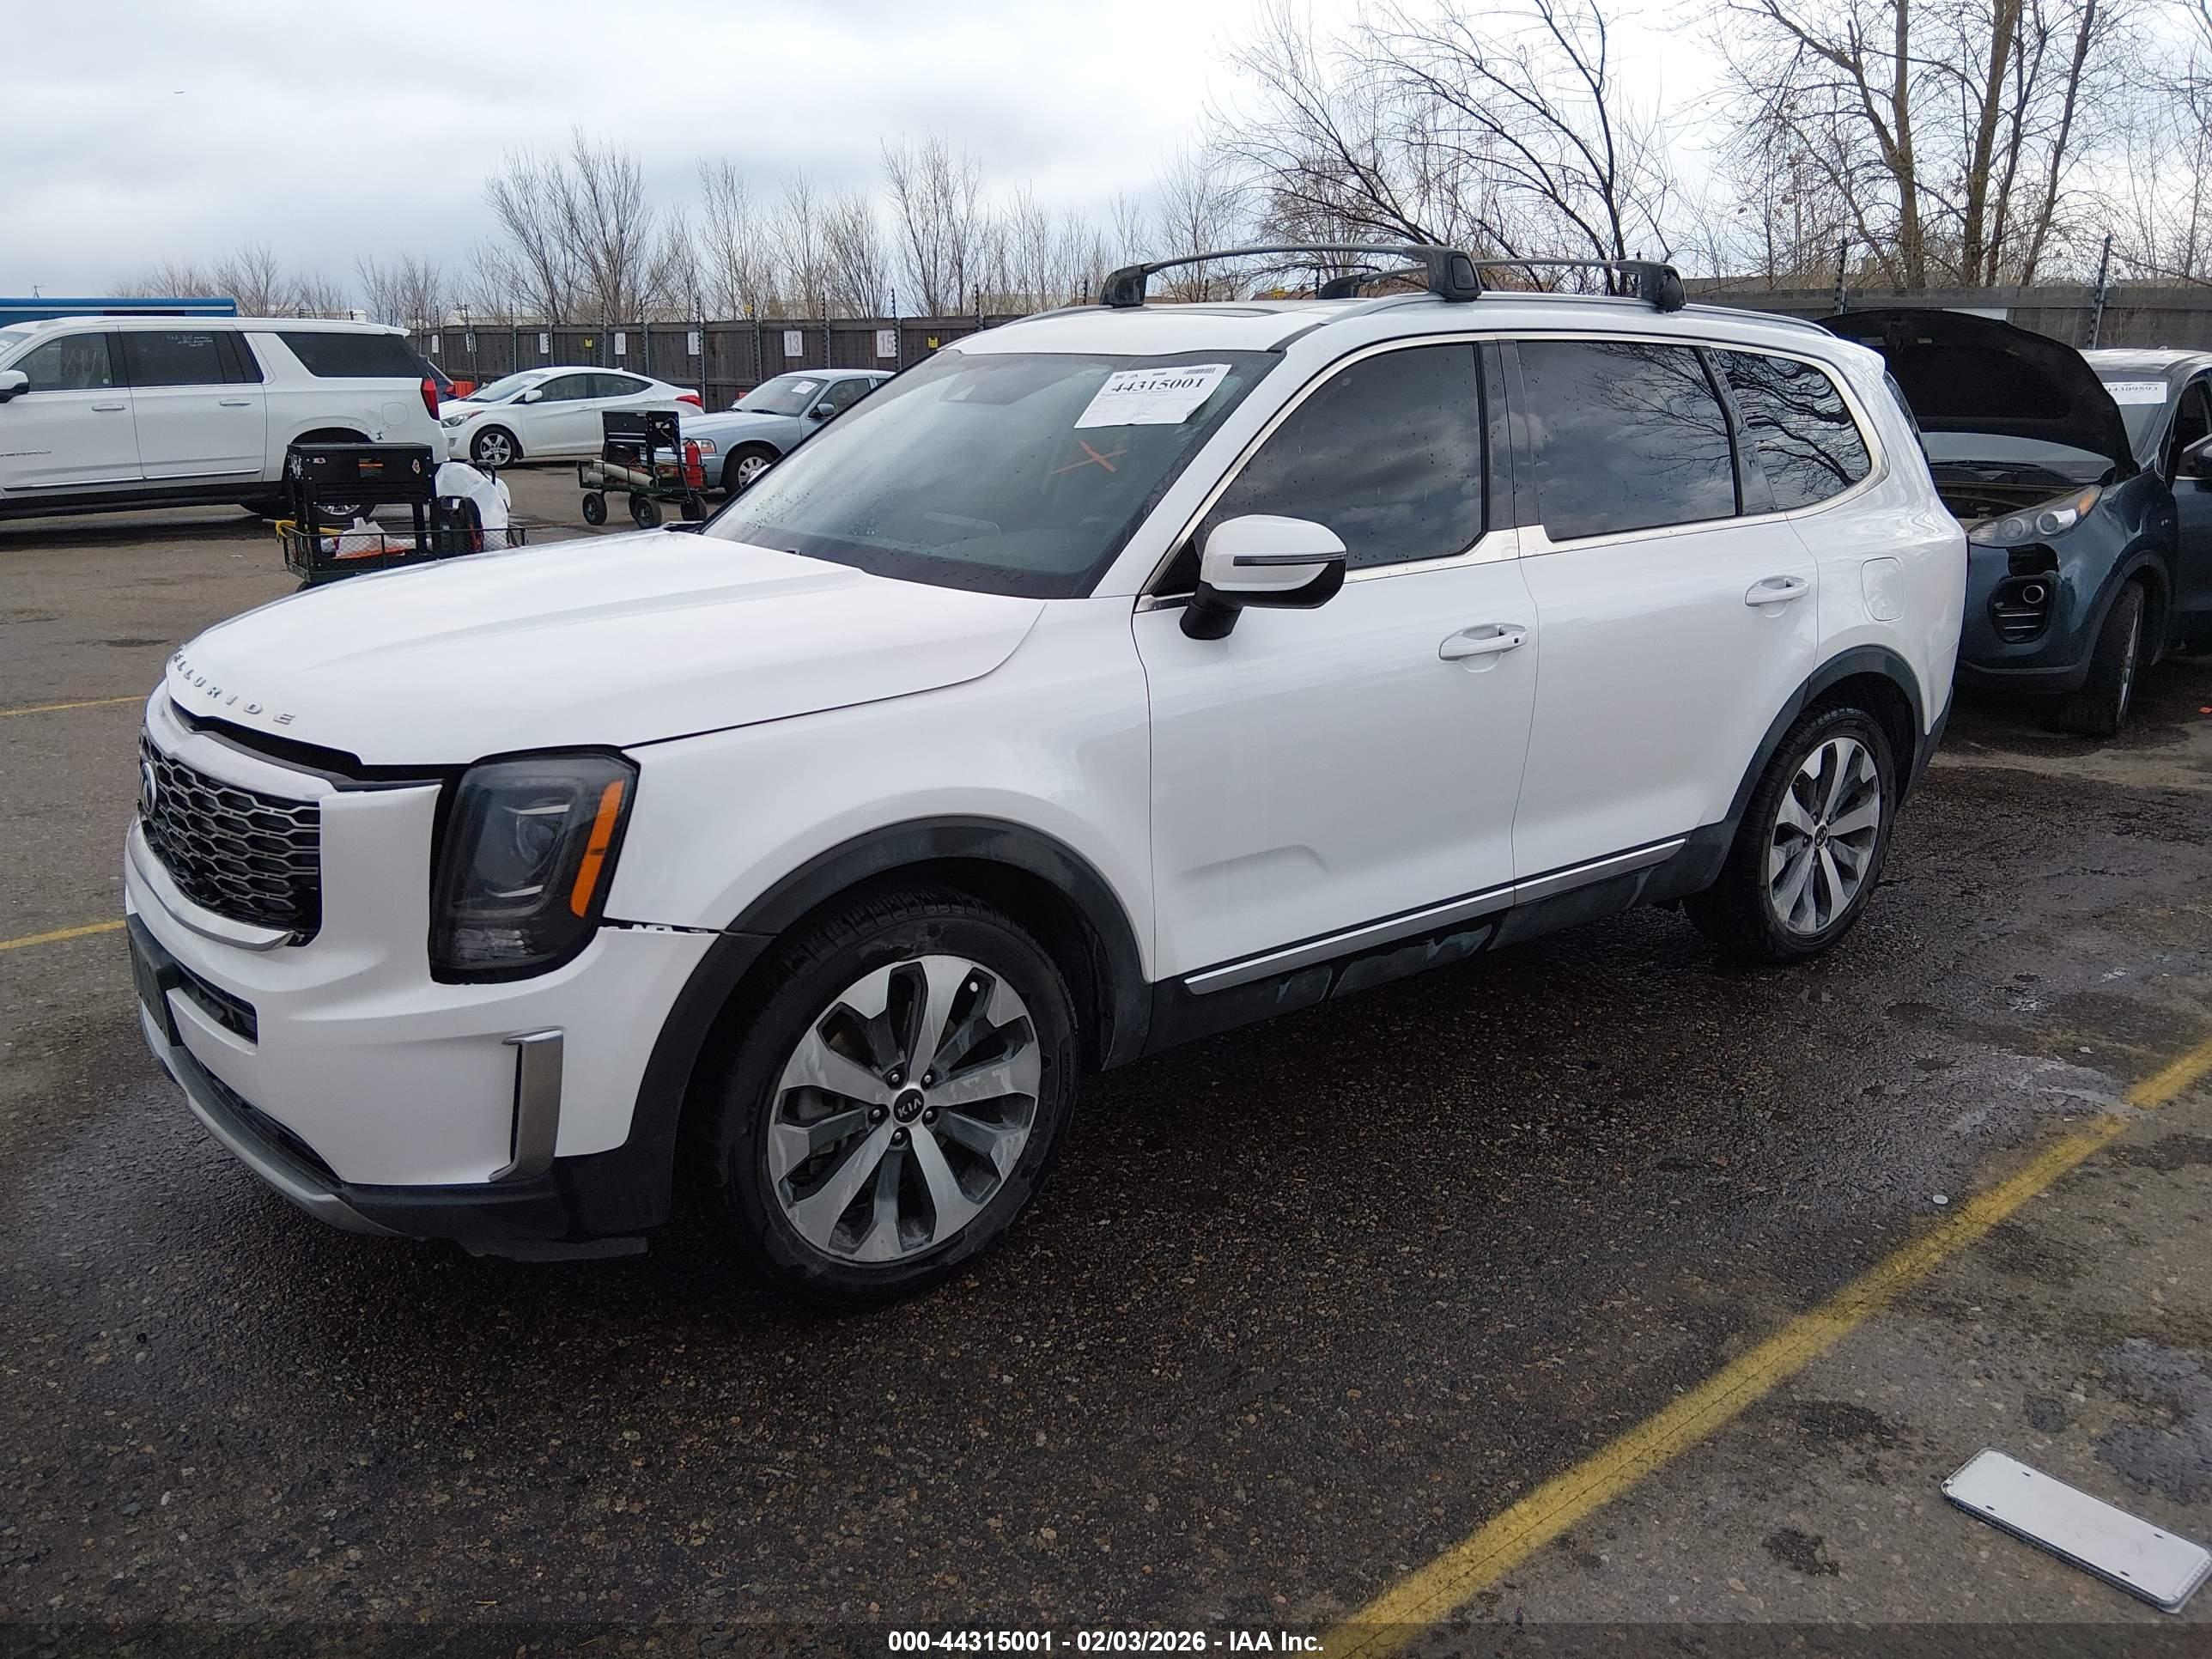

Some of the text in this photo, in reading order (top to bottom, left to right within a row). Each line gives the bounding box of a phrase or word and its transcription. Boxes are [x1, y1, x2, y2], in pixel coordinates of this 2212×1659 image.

[787, 334, 799, 352] 13
[879, 334, 894, 353] 15
[1111, 378, 1206, 392] 44315001
[896, 1097, 923, 1118] KIA
